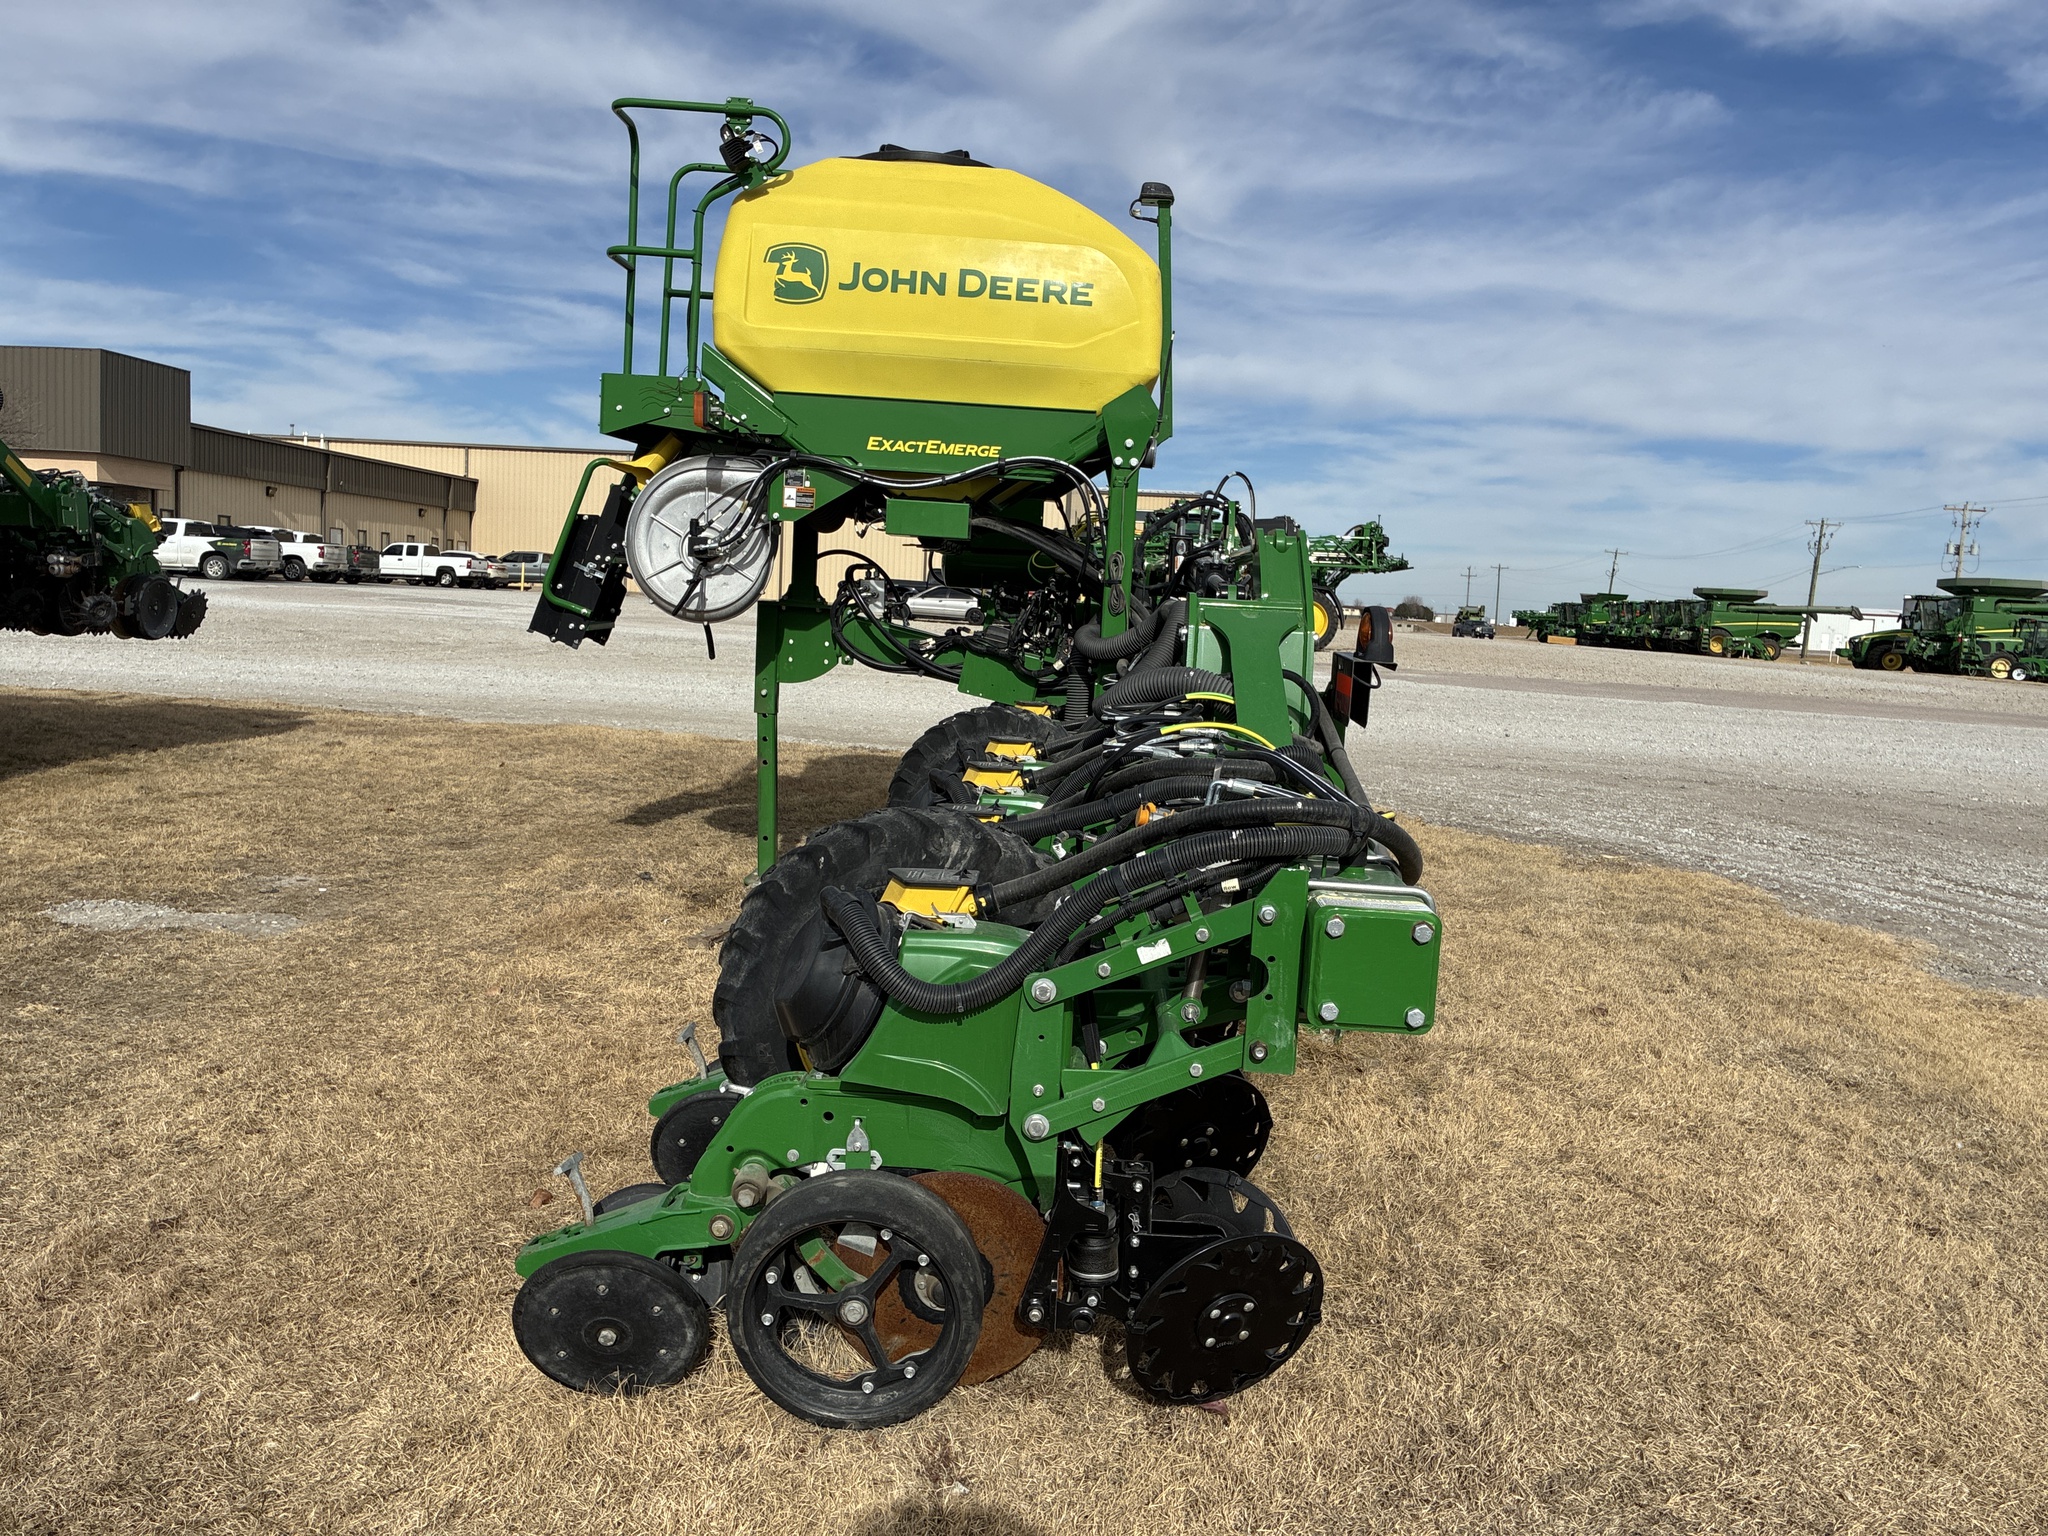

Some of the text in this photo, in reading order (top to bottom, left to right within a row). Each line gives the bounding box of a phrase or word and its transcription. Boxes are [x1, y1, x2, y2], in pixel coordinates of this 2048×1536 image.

[838, 261, 1095, 307] JOHN DEERE
[866, 436, 1002, 458] EXACTEMERGE
